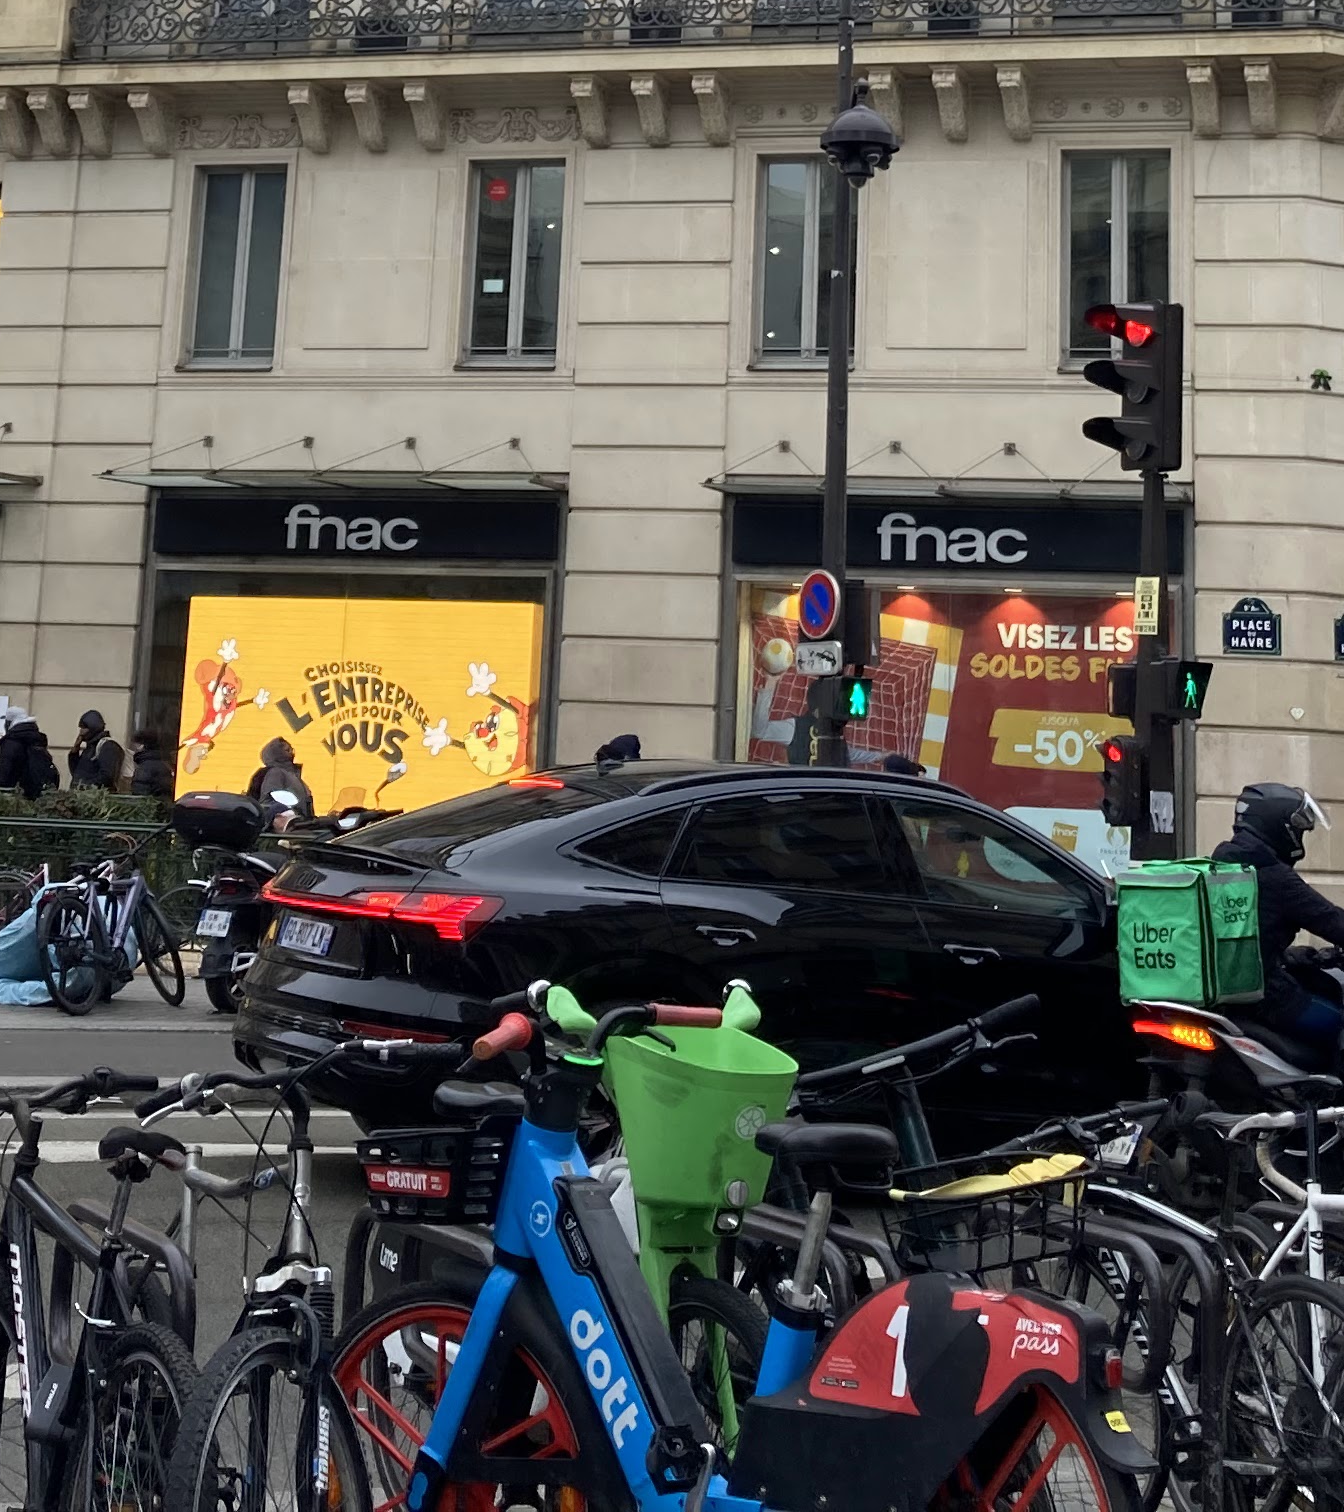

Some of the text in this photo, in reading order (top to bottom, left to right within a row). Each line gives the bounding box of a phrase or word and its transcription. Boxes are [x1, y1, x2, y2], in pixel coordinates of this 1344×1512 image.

[283, 503, 420, 552] fnac
[876, 511, 1029, 564] fnac
[1232, 619, 1271, 631] PLACE
[996, 623, 1134, 652] VISEZ LES
[1231, 637, 1273, 649] HAVRE
[303, 661, 383, 682] CHOISISSEZ
[970, 652, 1081, 682] SOLDES
[274, 676, 430, 734] L'ENTREPRISE
[329, 705, 403, 726] FAITE POUR
[320, 720, 410, 764] VOUS
[1221, 895, 1248, 909] Uber
[1223, 909, 1250, 924] Eats
[1133, 922, 1176, 943] Uber
[1134, 948, 1176, 969] Eats
[386, 1170, 428, 1191] GRATUIT
[1010, 1334, 1061, 1359] pass
[570, 1309, 639, 1450] dott
